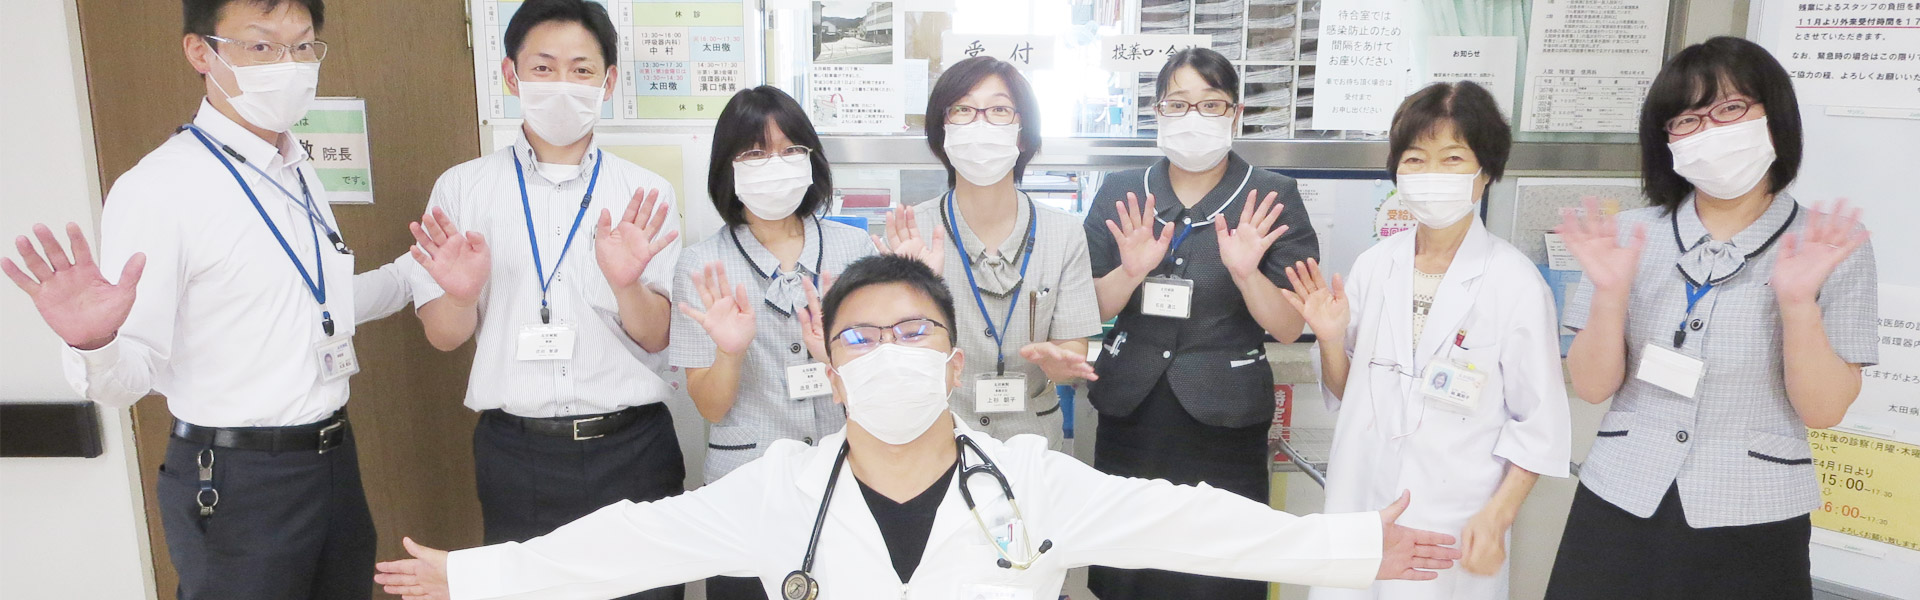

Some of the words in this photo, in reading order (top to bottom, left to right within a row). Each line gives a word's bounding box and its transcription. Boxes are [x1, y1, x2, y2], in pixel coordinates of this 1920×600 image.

[1338, 10, 1392, 21] 待合室では
[1326, 24, 1402, 36] 感染防止のため
[1331, 40, 1393, 51] 間隔をあけて
[1112, 44, 1201, 61] 投薬口・会
[1453, 50, 1480, 58] お知らせ
[1328, 55, 1393, 67] お座りください
[1344, 93, 1372, 101] 受付まで
[1332, 106, 1382, 114] お申し出ください
[322, 147, 352, 161] 院長
[342, 175, 366, 186] です。
[1380, 227, 1409, 237] 毎回
[1860, 368, 1920, 384] しますがよろ
[1809, 441, 1839, 455] ついて
[1818, 501, 1888, 526] 6:00～17:30
